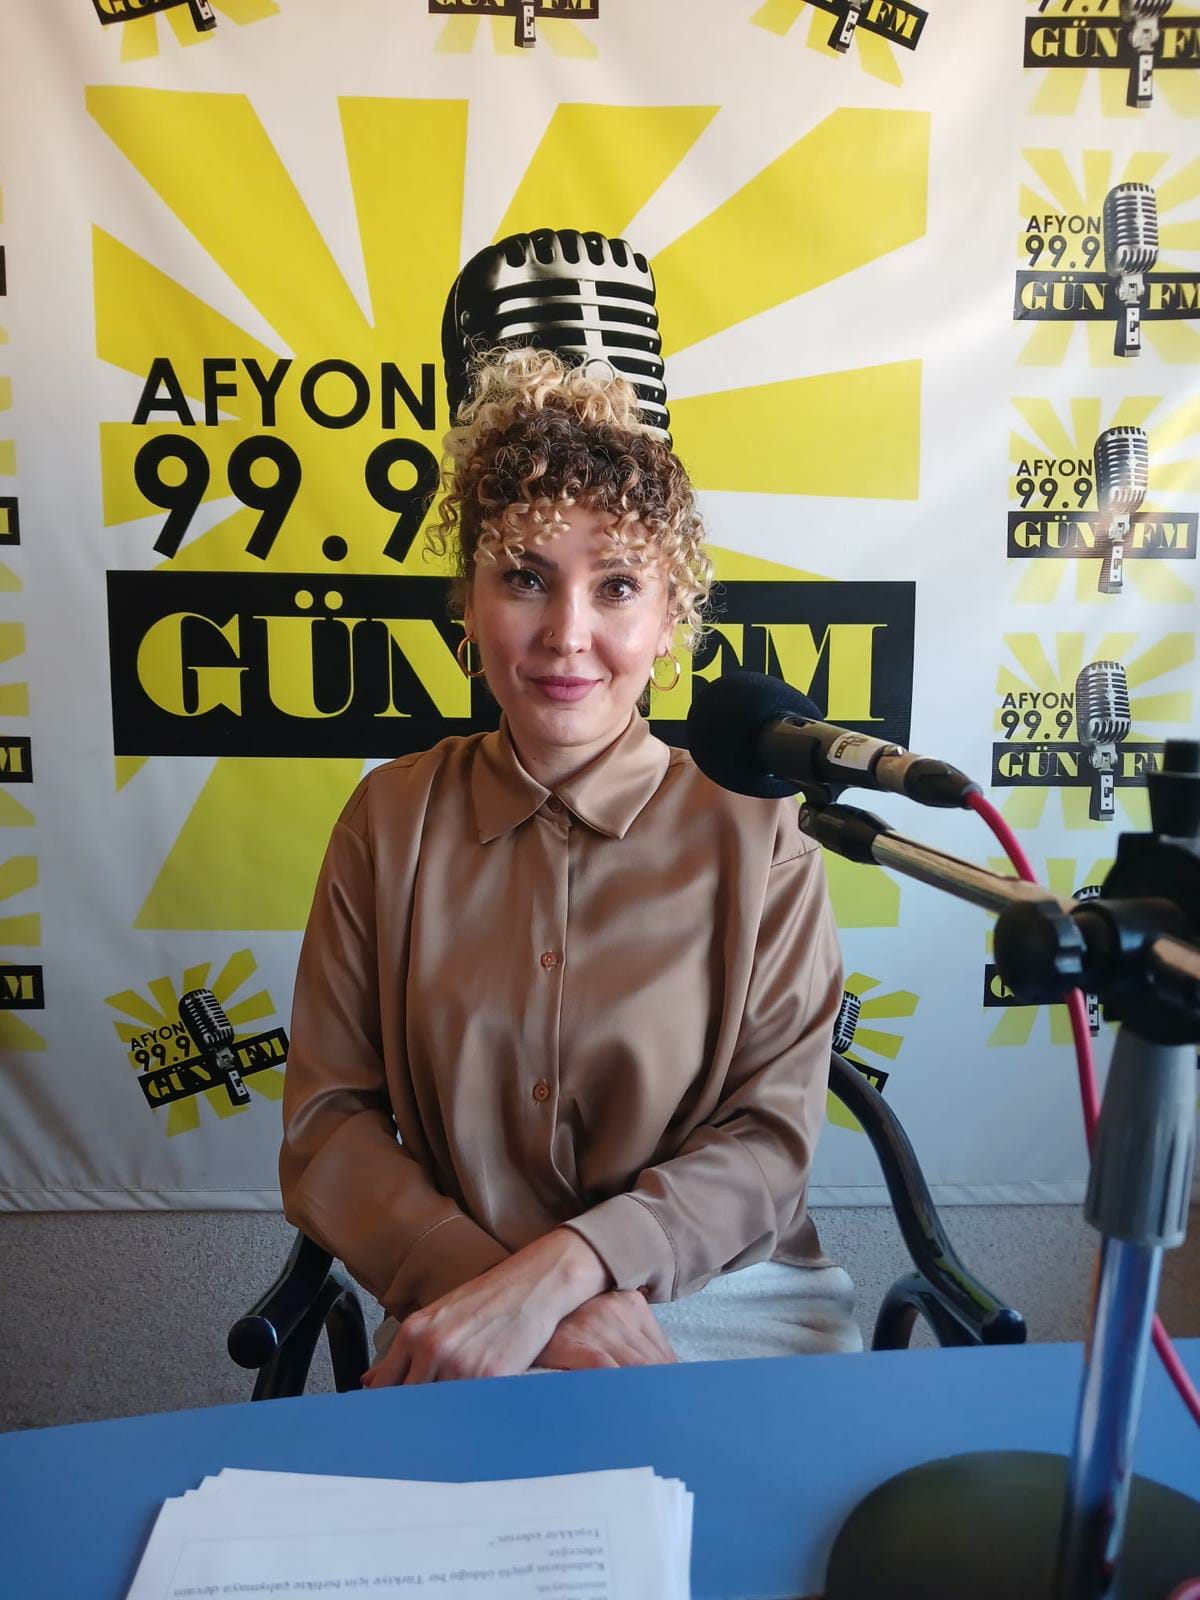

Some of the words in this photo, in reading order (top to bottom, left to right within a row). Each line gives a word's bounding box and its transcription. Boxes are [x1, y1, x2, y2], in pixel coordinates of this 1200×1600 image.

[866, 0, 918, 40] FM
[1031, 20, 1122, 58] GÜN
[1162, 28, 1200, 58] F
[1026, 215, 1101, 234] AFYON
[1025, 235, 1101, 269] 99.9
[1021, 276, 1108, 310] GÜN
[132, 357, 436, 430] AFYON
[1016, 459, 1092, 477] AFYON
[134, 433, 440, 563] 99.9
[1016, 477, 1093, 509] 99.9
[1014, 515, 1099, 548] GÜN
[1131, 522, 1191, 548] FM
[136, 590, 472, 718] GÜN
[645, 623, 888, 721] FM
[1002, 692, 1074, 709] AFYON
[1001, 710, 1073, 740] 99.9
[998, 746, 1082, 778] GÜN
[4, 975, 34, 1000] M
[131, 1021, 185, 1051] AFYON
[134, 1035, 190, 1072] 99.9
[148, 1064, 212, 1098] GÜN
[237, 1037, 285, 1068] FM
